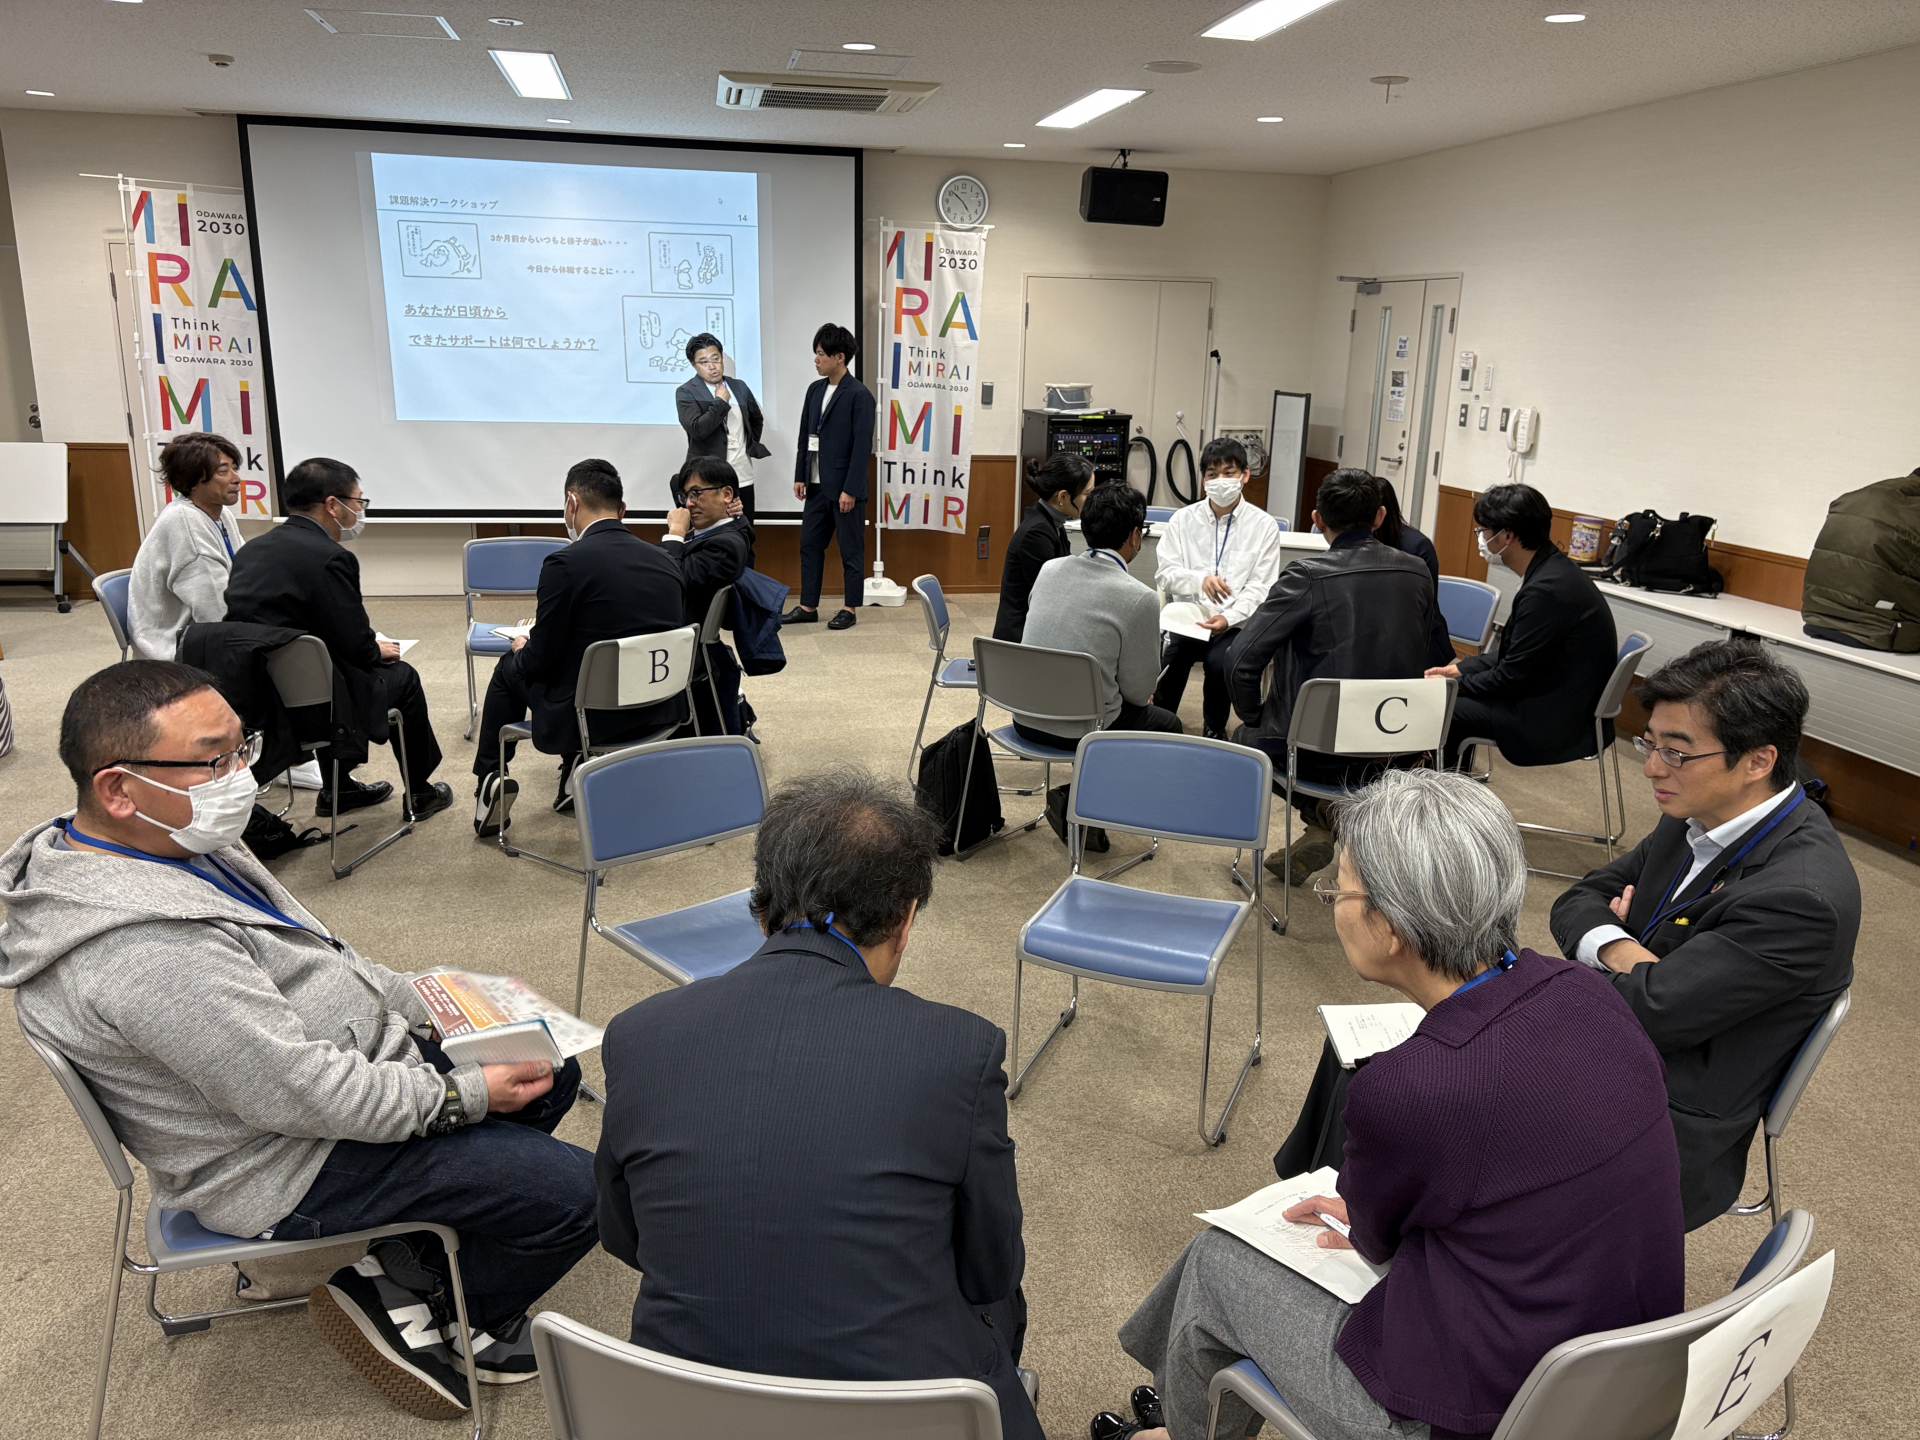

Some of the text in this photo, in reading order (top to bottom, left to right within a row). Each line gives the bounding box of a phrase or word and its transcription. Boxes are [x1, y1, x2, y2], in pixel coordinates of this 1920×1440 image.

[389, 195, 499, 210] 課題解決ワークショップ
[196, 210, 244, 221] ODAWARA
[738, 214, 748, 222] 14
[197, 220, 245, 236] 2030
[939, 247, 978, 256] ODAWARA
[938, 256, 978, 270] 2030
[404, 304, 507, 318] あなたが日頃から
[171, 317, 220, 332] Think
[409, 334, 596, 349] できたサポートは何でしょうか？
[908, 346, 946, 360] Think
[175, 355, 253, 367] ODAWARA 2030
[907, 381, 946, 390] ODAWARA
[884, 461, 965, 489] Think
[648, 649, 670, 684] B
[1374, 697, 1408, 734] C
[1704, 1328, 1772, 1429] E
